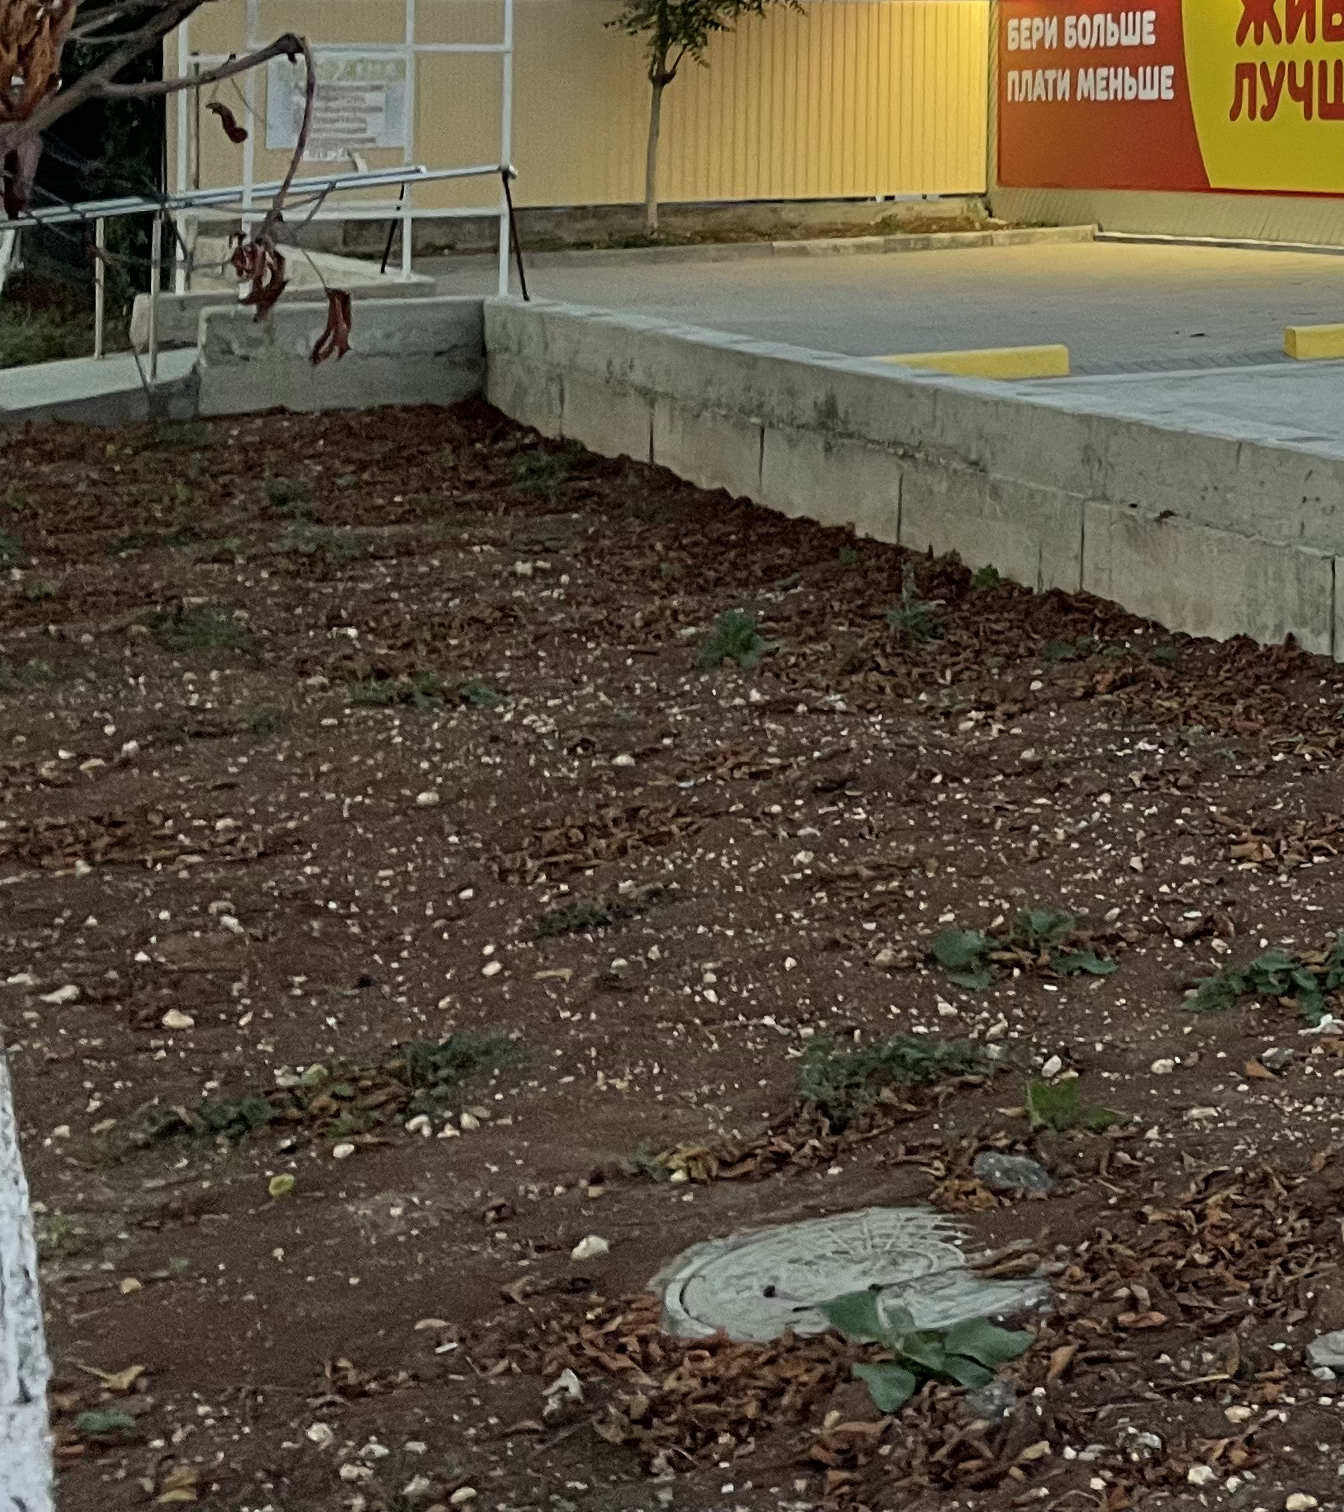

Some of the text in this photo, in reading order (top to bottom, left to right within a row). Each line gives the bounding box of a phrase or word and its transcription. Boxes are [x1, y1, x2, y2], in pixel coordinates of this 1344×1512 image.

[1007, 10, 1157, 51] БЕРИ БОЛЬШЕ
[1007, 65, 1175, 102] ПЛАТИ МЕНЬШЕ
